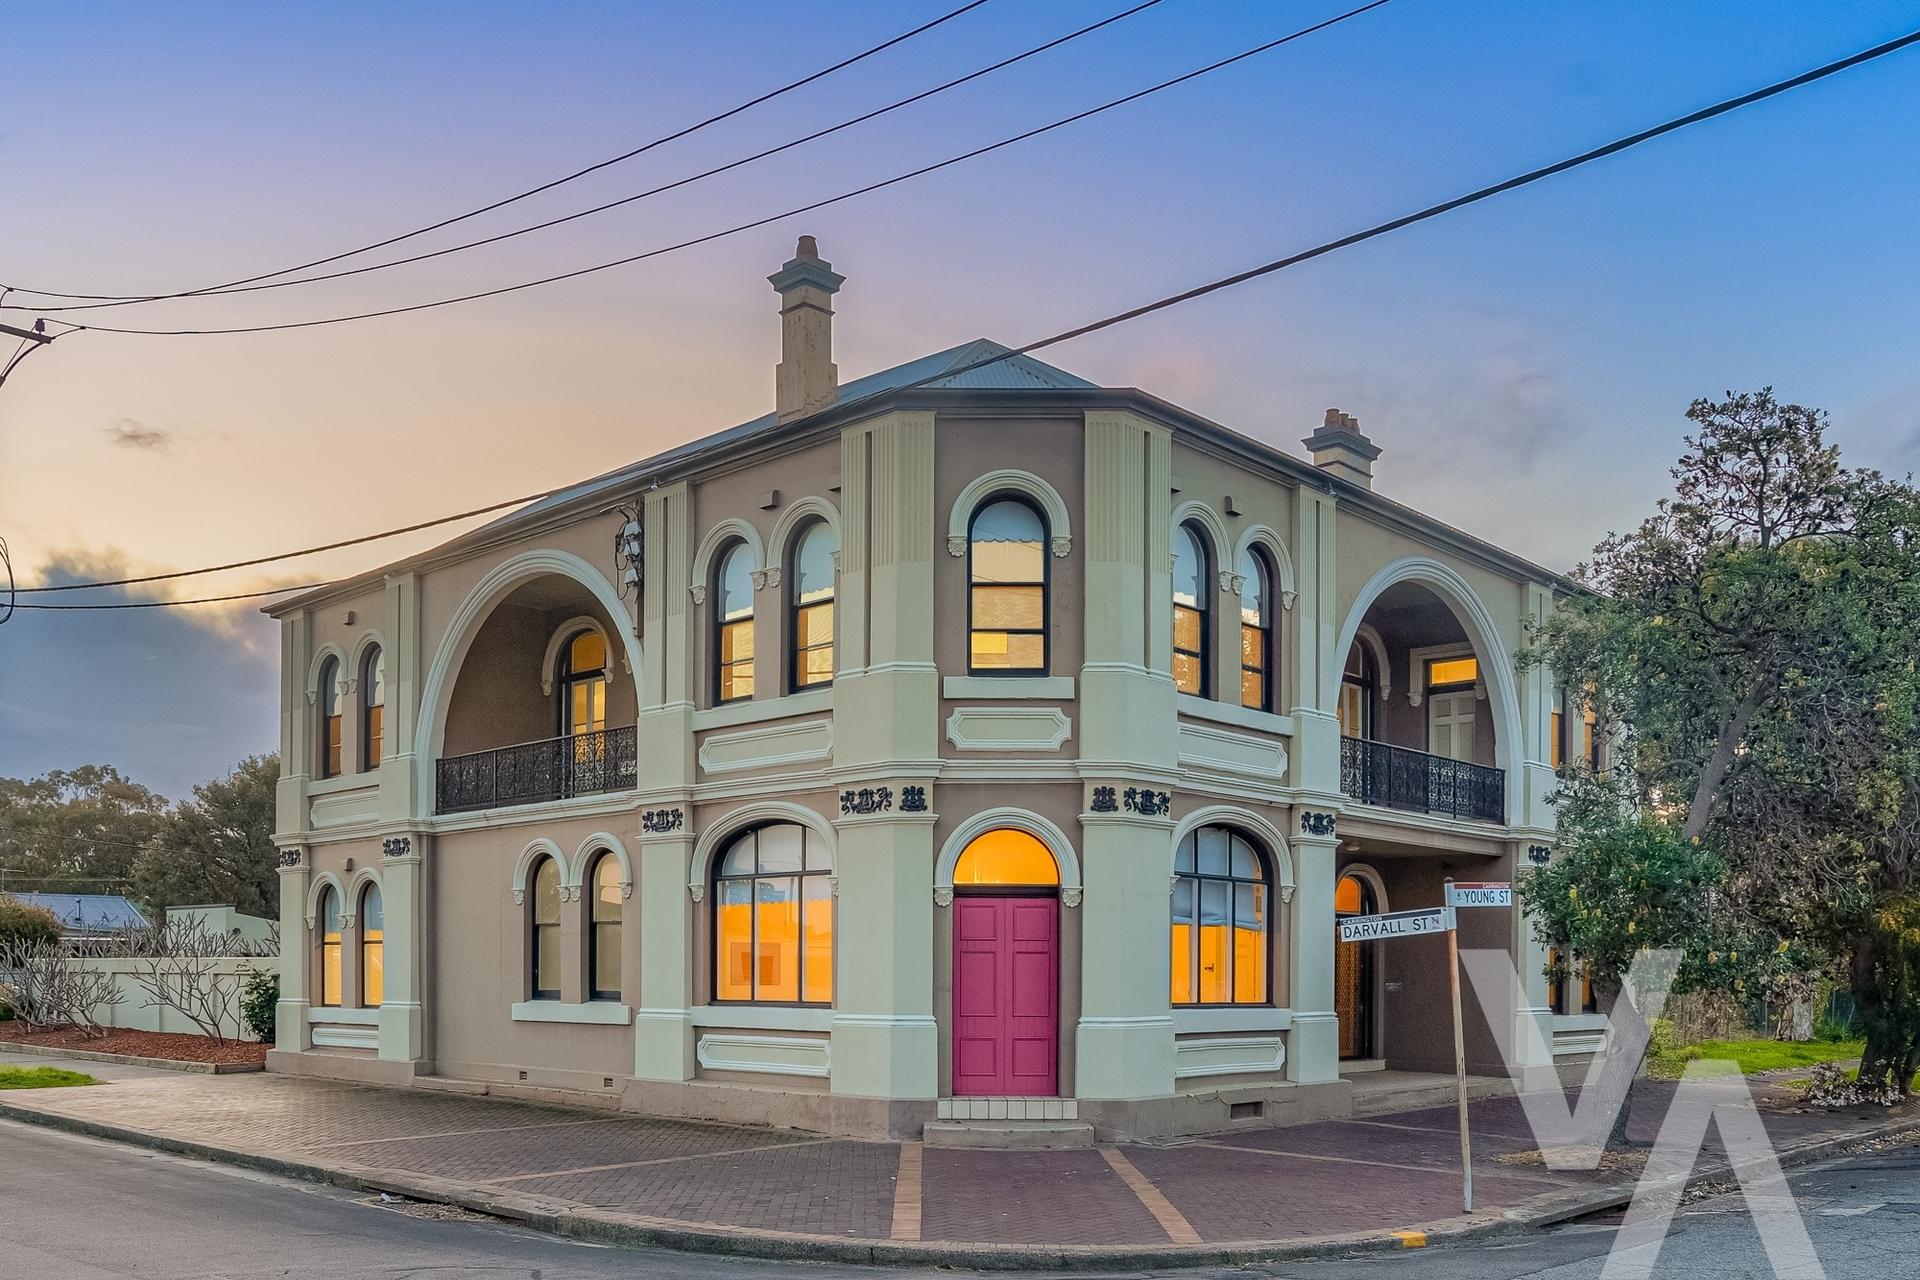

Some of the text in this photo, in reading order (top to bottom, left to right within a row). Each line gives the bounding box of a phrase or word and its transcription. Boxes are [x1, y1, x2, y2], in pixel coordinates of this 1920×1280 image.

[1464, 890, 1509, 903] YOUNG ST
[1344, 917, 1428, 938] DARVALL ST
